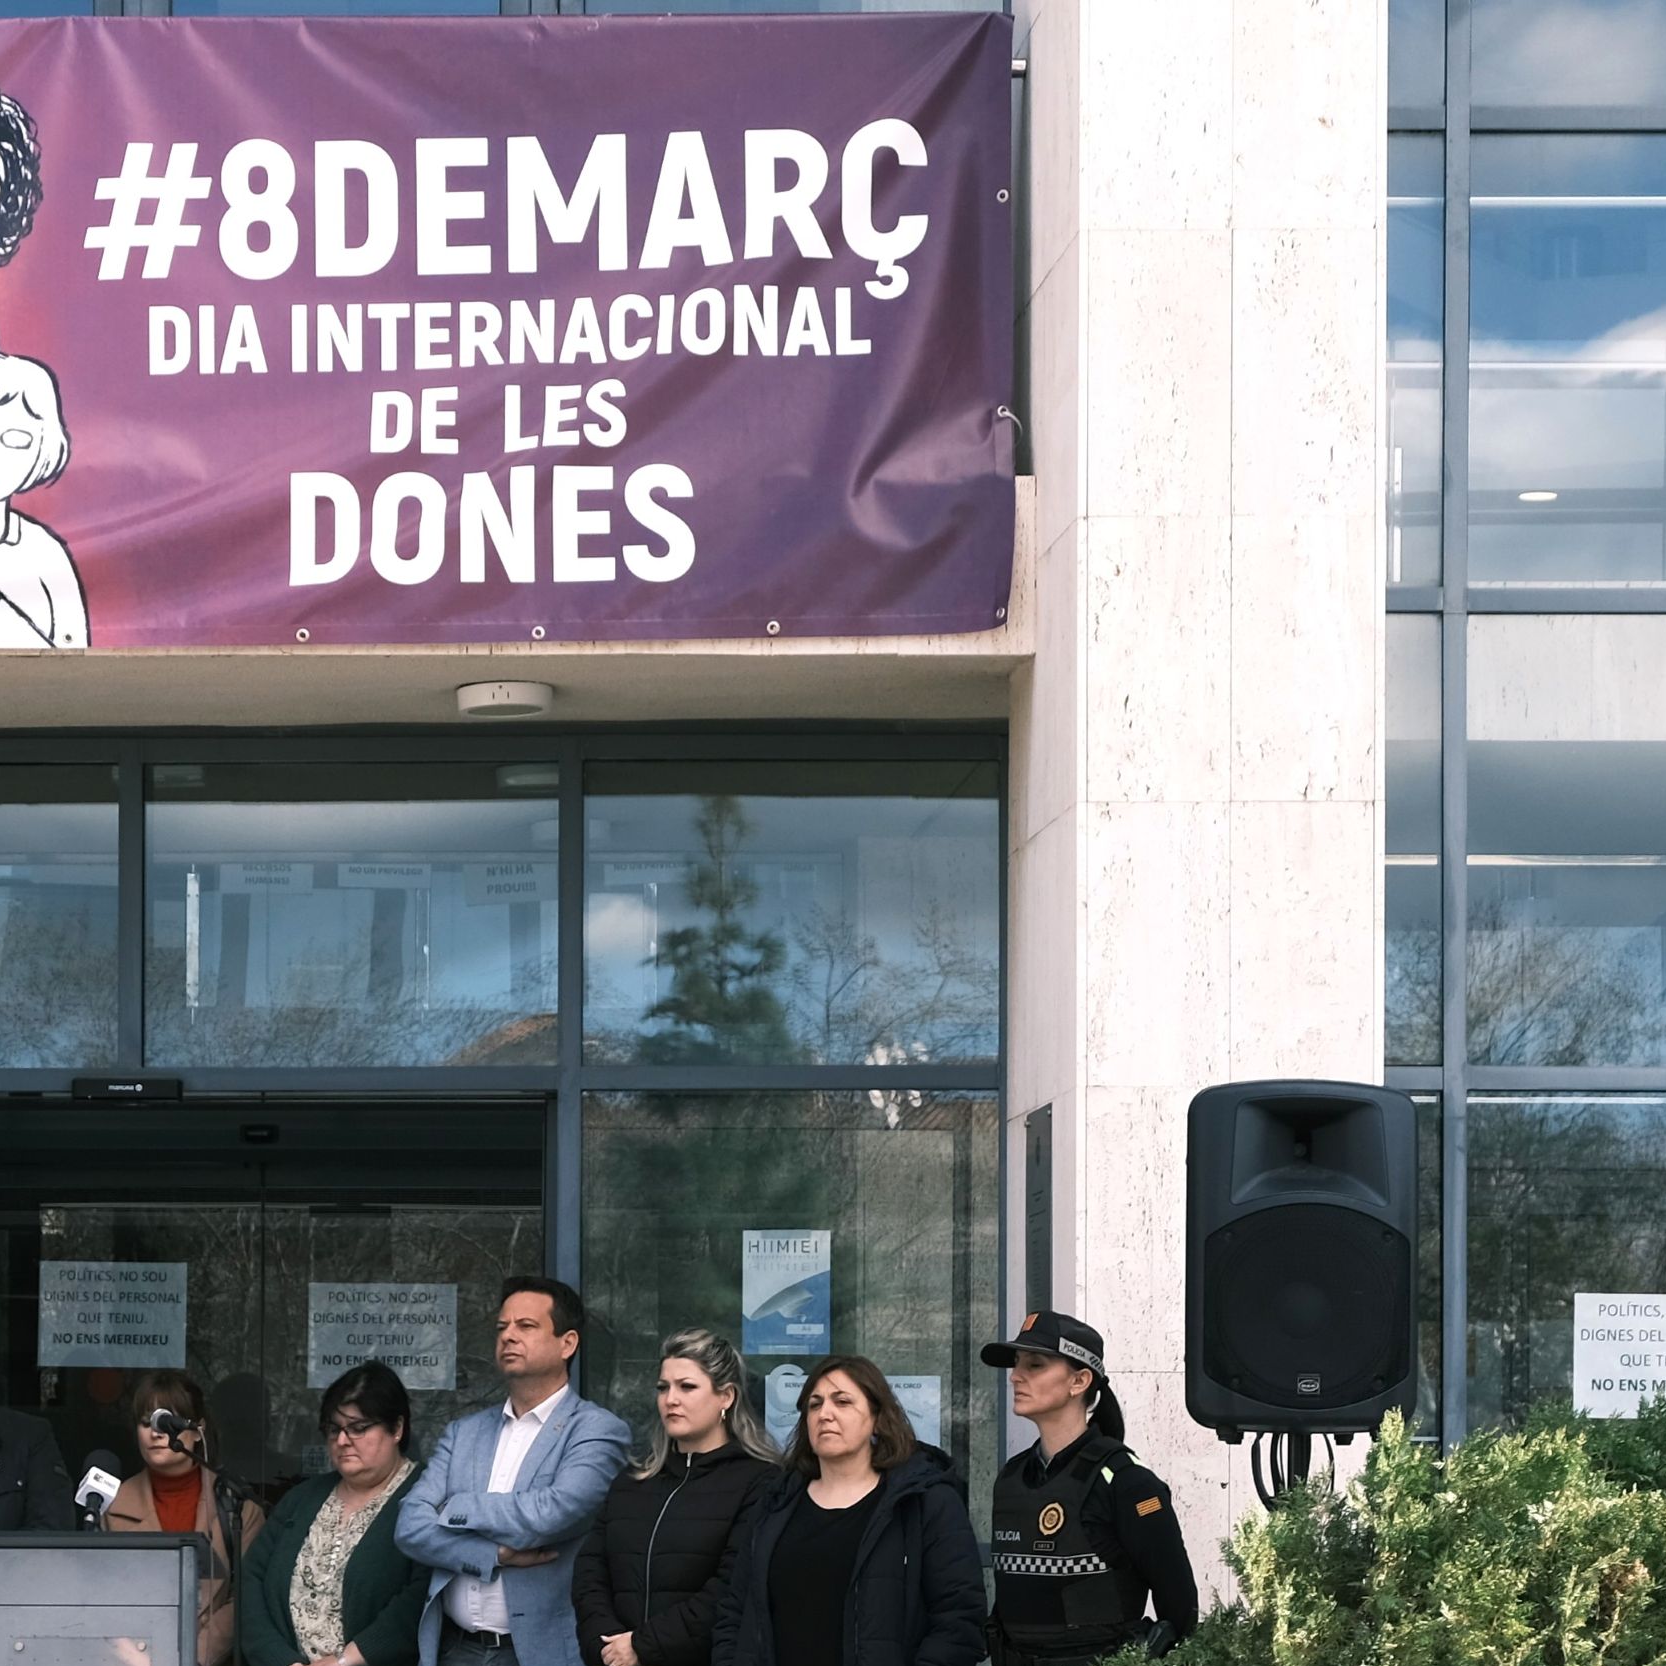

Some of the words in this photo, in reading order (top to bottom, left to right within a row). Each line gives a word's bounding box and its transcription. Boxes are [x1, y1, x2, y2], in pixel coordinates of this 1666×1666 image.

[83, 117, 929, 300] #8DEMARÇ
[148, 304, 268, 376] DIA
[290, 284, 872, 375] INTERNACIONAL
[369, 386, 459, 454] DE
[503, 378, 629, 453] LES
[288, 463, 697, 587] DONES
[119, 1271, 138, 1282] NO
[142, 1271, 167, 1282] SOU
[44, 1290, 89, 1302] DIGNES
[93, 1291, 114, 1302] DEL
[119, 1291, 182, 1304] PERSONAL
[388, 1292, 408, 1303] NO
[411, 1292, 438, 1303] SOU
[1598, 1302, 1665, 1319] POLÍTICS,
[77, 1312, 102, 1324] QUE
[313, 1312, 360, 1324] DIGNES
[362, 1313, 383, 1324] DEL
[388, 1313, 453, 1325] PERSONAL
[52, 1333, 72, 1344] NO
[76, 1333, 101, 1344] ENS
[103, 1334, 169, 1345] MEREIXEU
[346, 1334, 374, 1345] QUE
[1580, 1328, 1634, 1342] DIGNES
[1638, 1329, 1664, 1343] DEL
[322, 1355, 342, 1366] NO
[1619, 1353, 1651, 1369] QUE
[1591, 1379, 1614, 1391] NO
[1619, 1379, 1647, 1391] ENS
